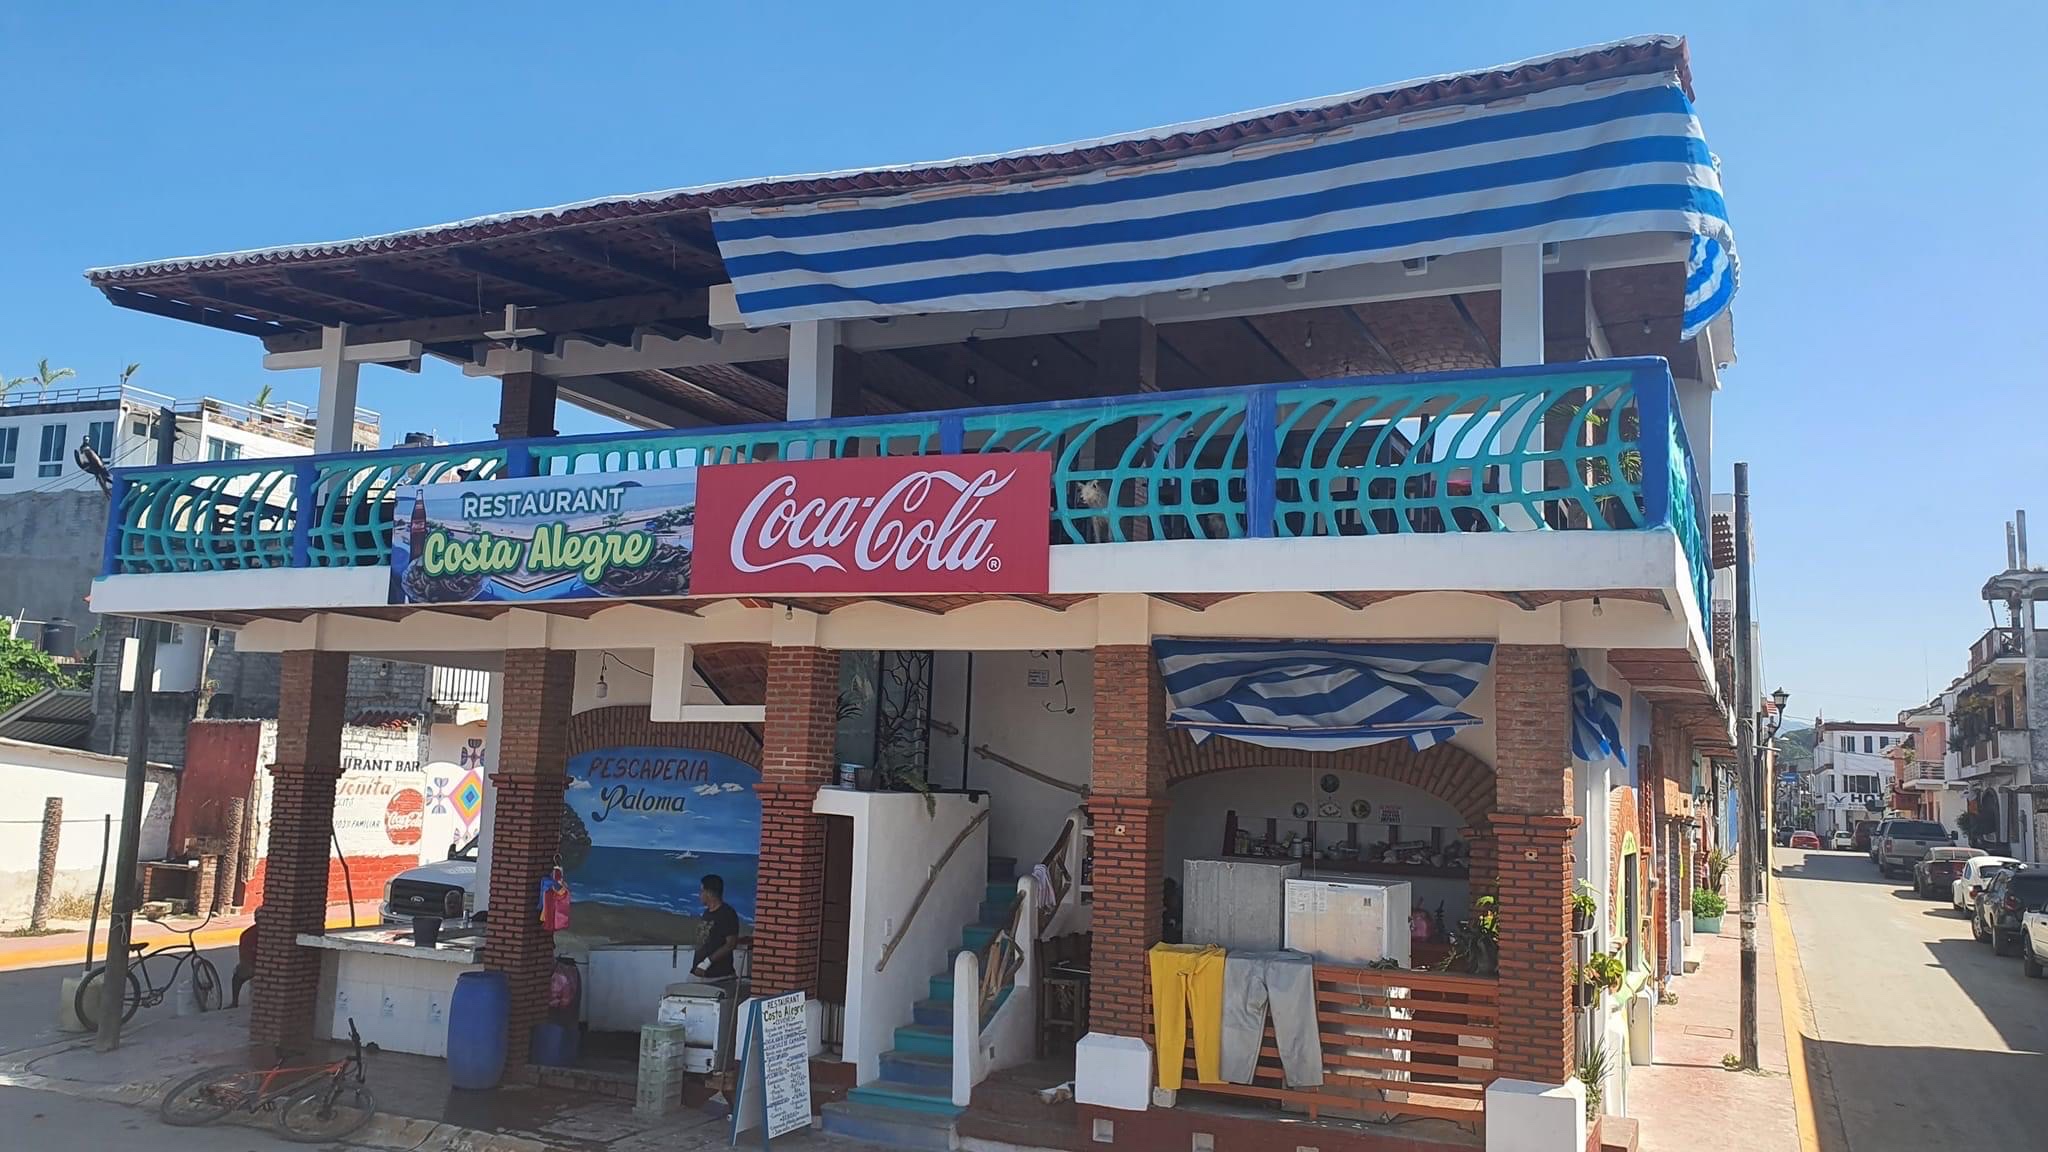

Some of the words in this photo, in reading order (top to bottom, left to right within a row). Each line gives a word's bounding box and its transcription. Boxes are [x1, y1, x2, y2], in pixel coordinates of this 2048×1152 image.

[463, 487, 625, 519] RESTAURANT
[730, 468, 1017, 574] Coca-Cola
[423, 532, 522, 575] Costa
[527, 524, 653, 582] Alegre
[395, 759, 421, 772] BAR
[588, 757, 709, 781] PESCADERIA
[592, 784, 686, 822] Paloma
[767, 994, 801, 1009] RESTAURANT
